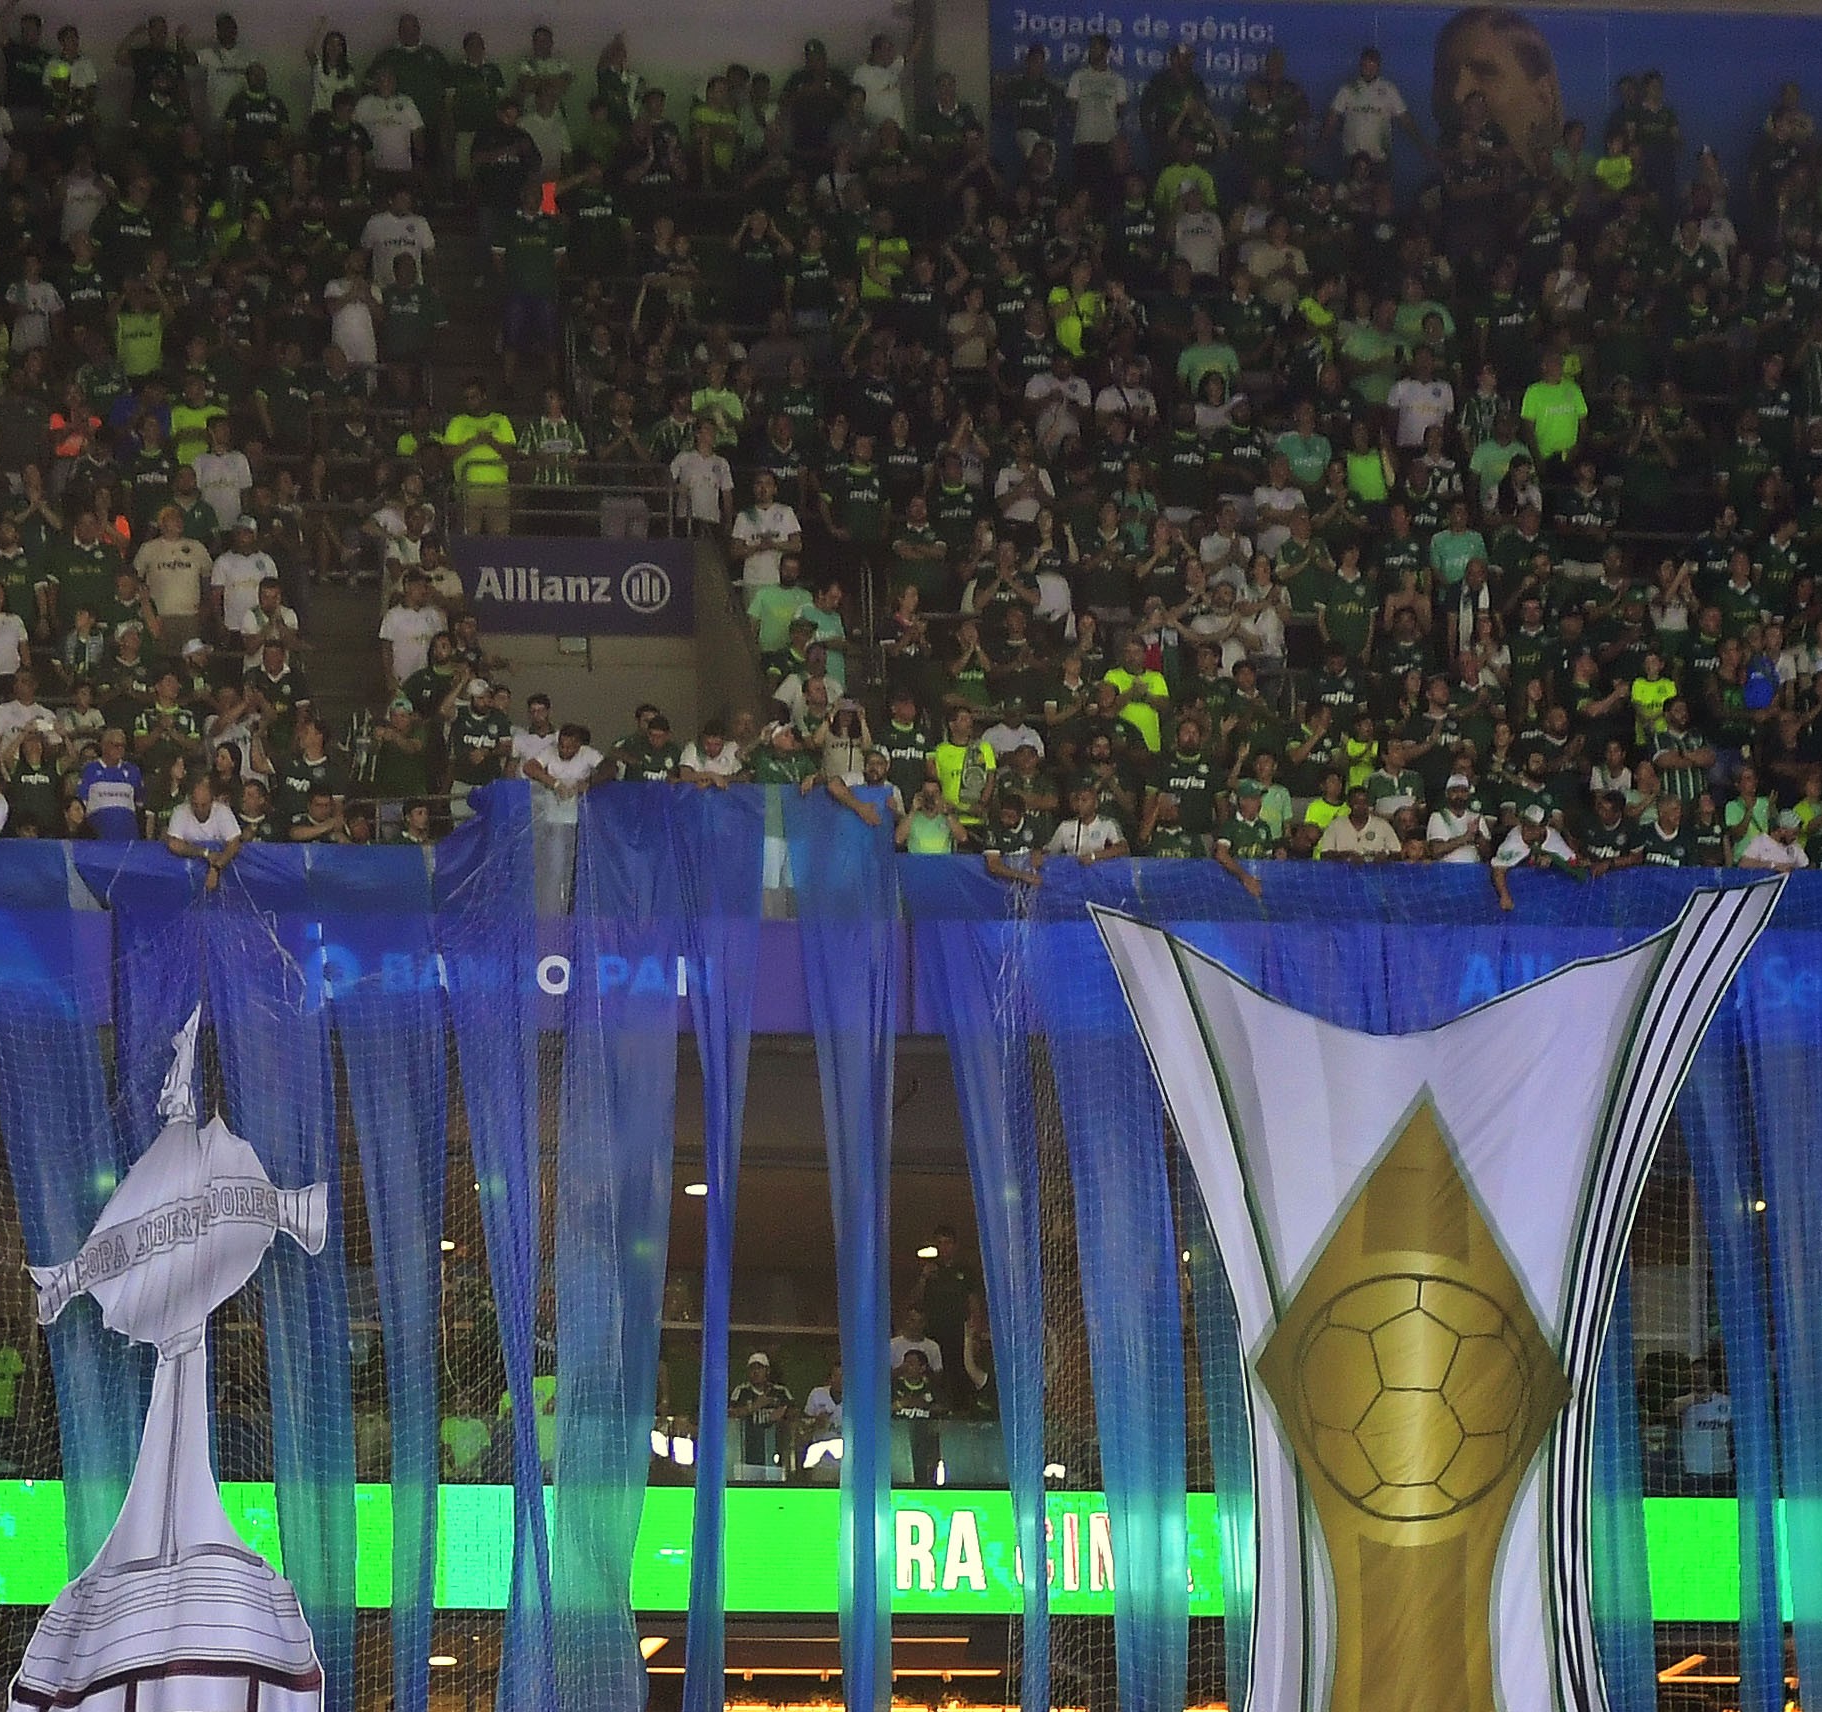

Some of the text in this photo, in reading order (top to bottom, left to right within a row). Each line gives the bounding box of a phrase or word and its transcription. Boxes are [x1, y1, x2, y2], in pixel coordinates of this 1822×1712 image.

[1133, 13, 1170, 37] de
[474, 566, 612, 605] Allianz
[75, 1234, 129, 1285] COPA
